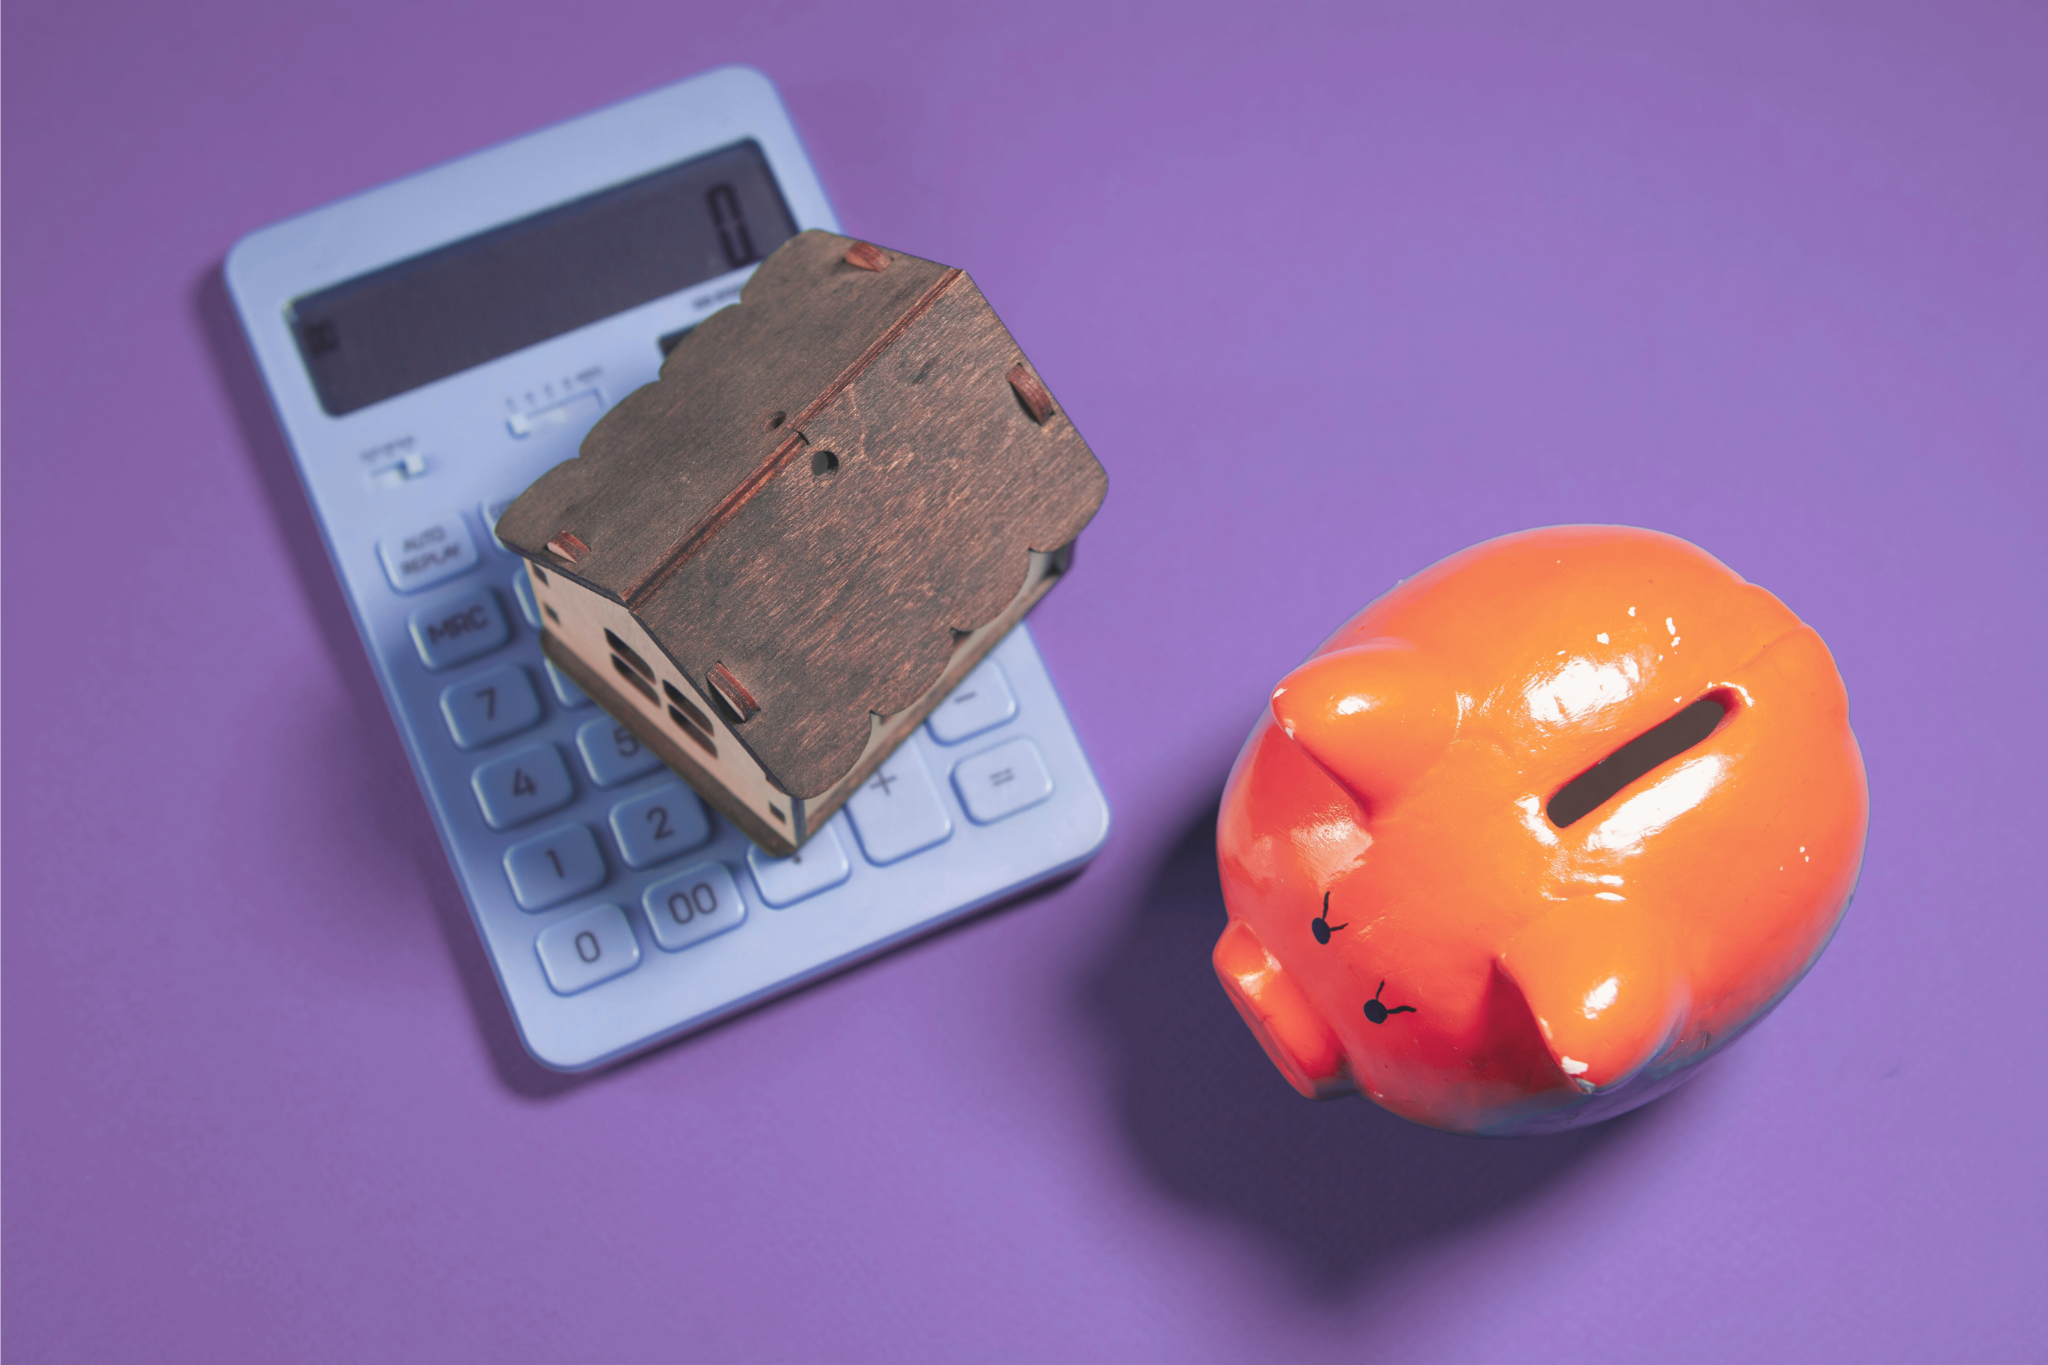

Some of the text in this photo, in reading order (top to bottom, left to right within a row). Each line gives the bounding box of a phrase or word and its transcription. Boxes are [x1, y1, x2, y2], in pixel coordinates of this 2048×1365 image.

[403, 524, 446, 551] AUTO
[401, 542, 461, 575] REPLAY
[425, 604, 490, 646] MRC
[475, 685, 497, 721] 7
[613, 726, 639, 758] 5
[512, 766, 537, 797] 4
[645, 805, 676, 841] 2
[545, 848, 565, 879] 1
[667, 882, 718, 925] 00
[574, 930, 601, 964] 0
